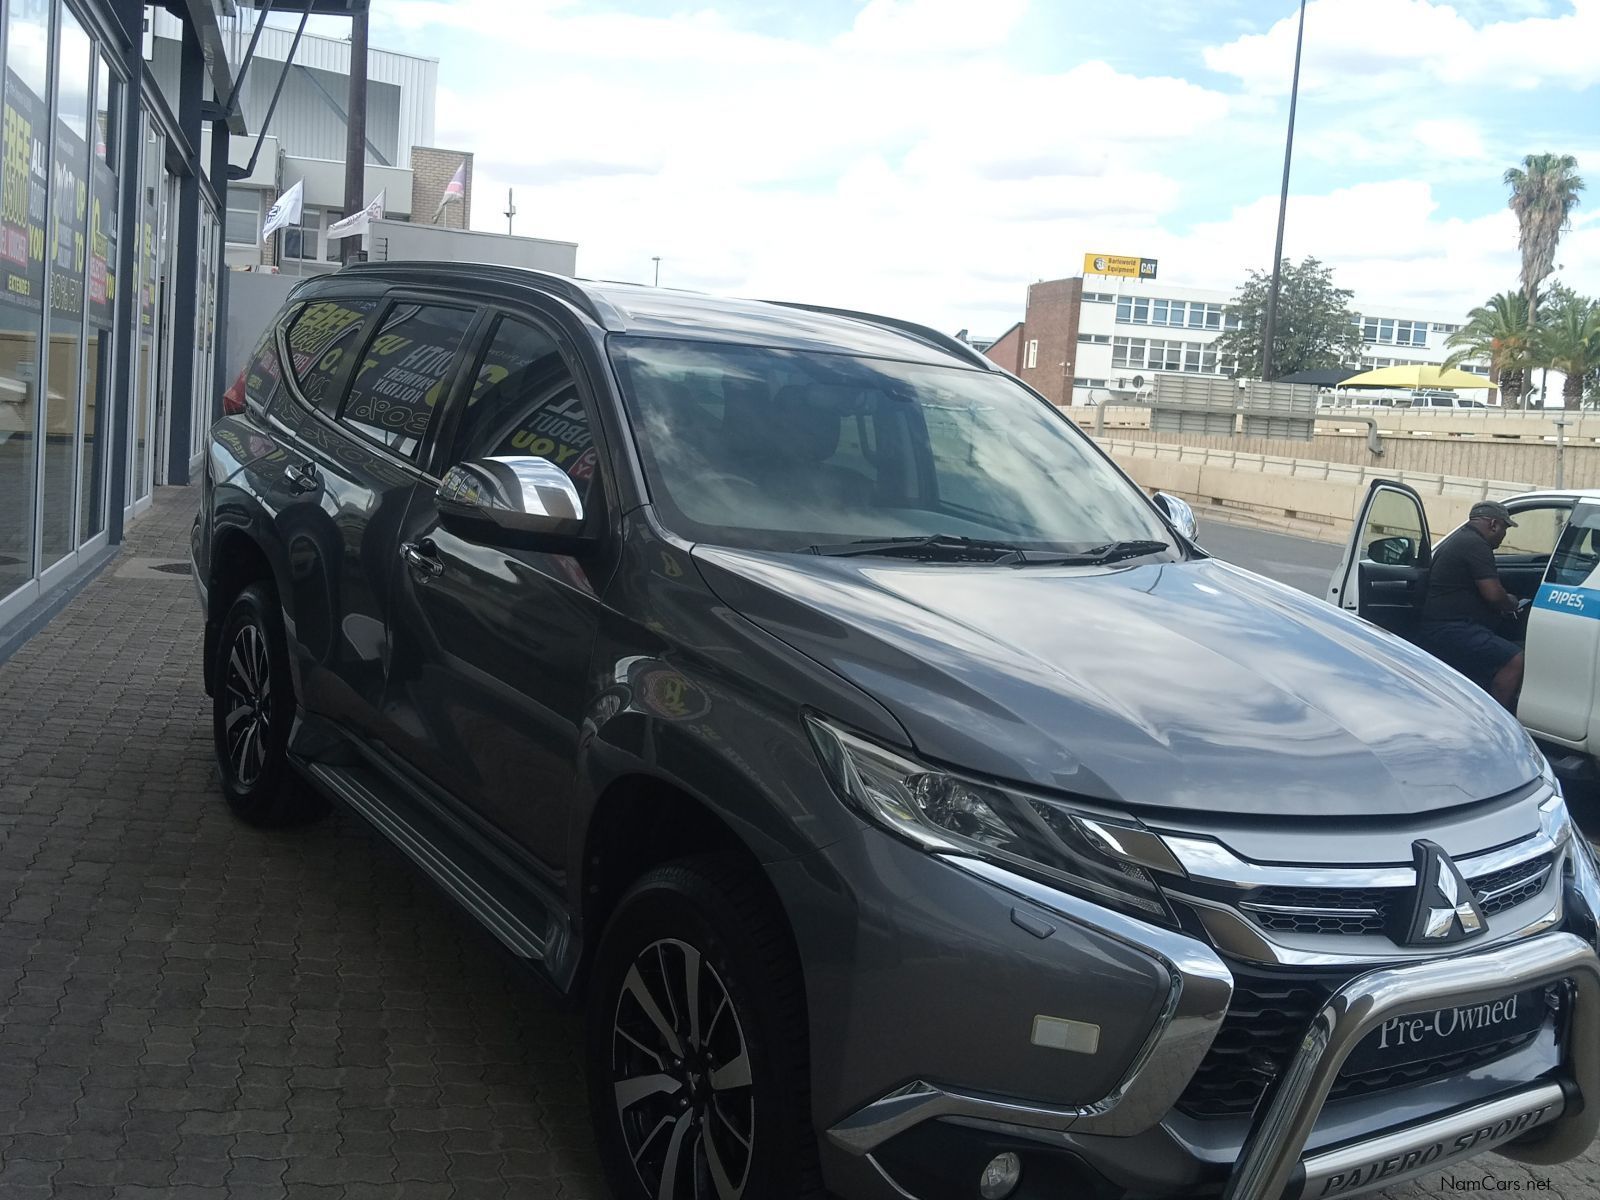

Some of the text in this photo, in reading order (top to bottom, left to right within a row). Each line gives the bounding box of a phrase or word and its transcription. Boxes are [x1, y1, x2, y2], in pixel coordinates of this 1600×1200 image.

[28, 223, 45, 262] YOU
[74, 231, 84, 273] TO
[1140, 262, 1156, 274] CAT
[1548, 589, 1585, 611] PIPES,
[1378, 994, 1518, 1050] Pre-Owned
[1320, 1105, 1552, 1197] PAJERO SPORT
